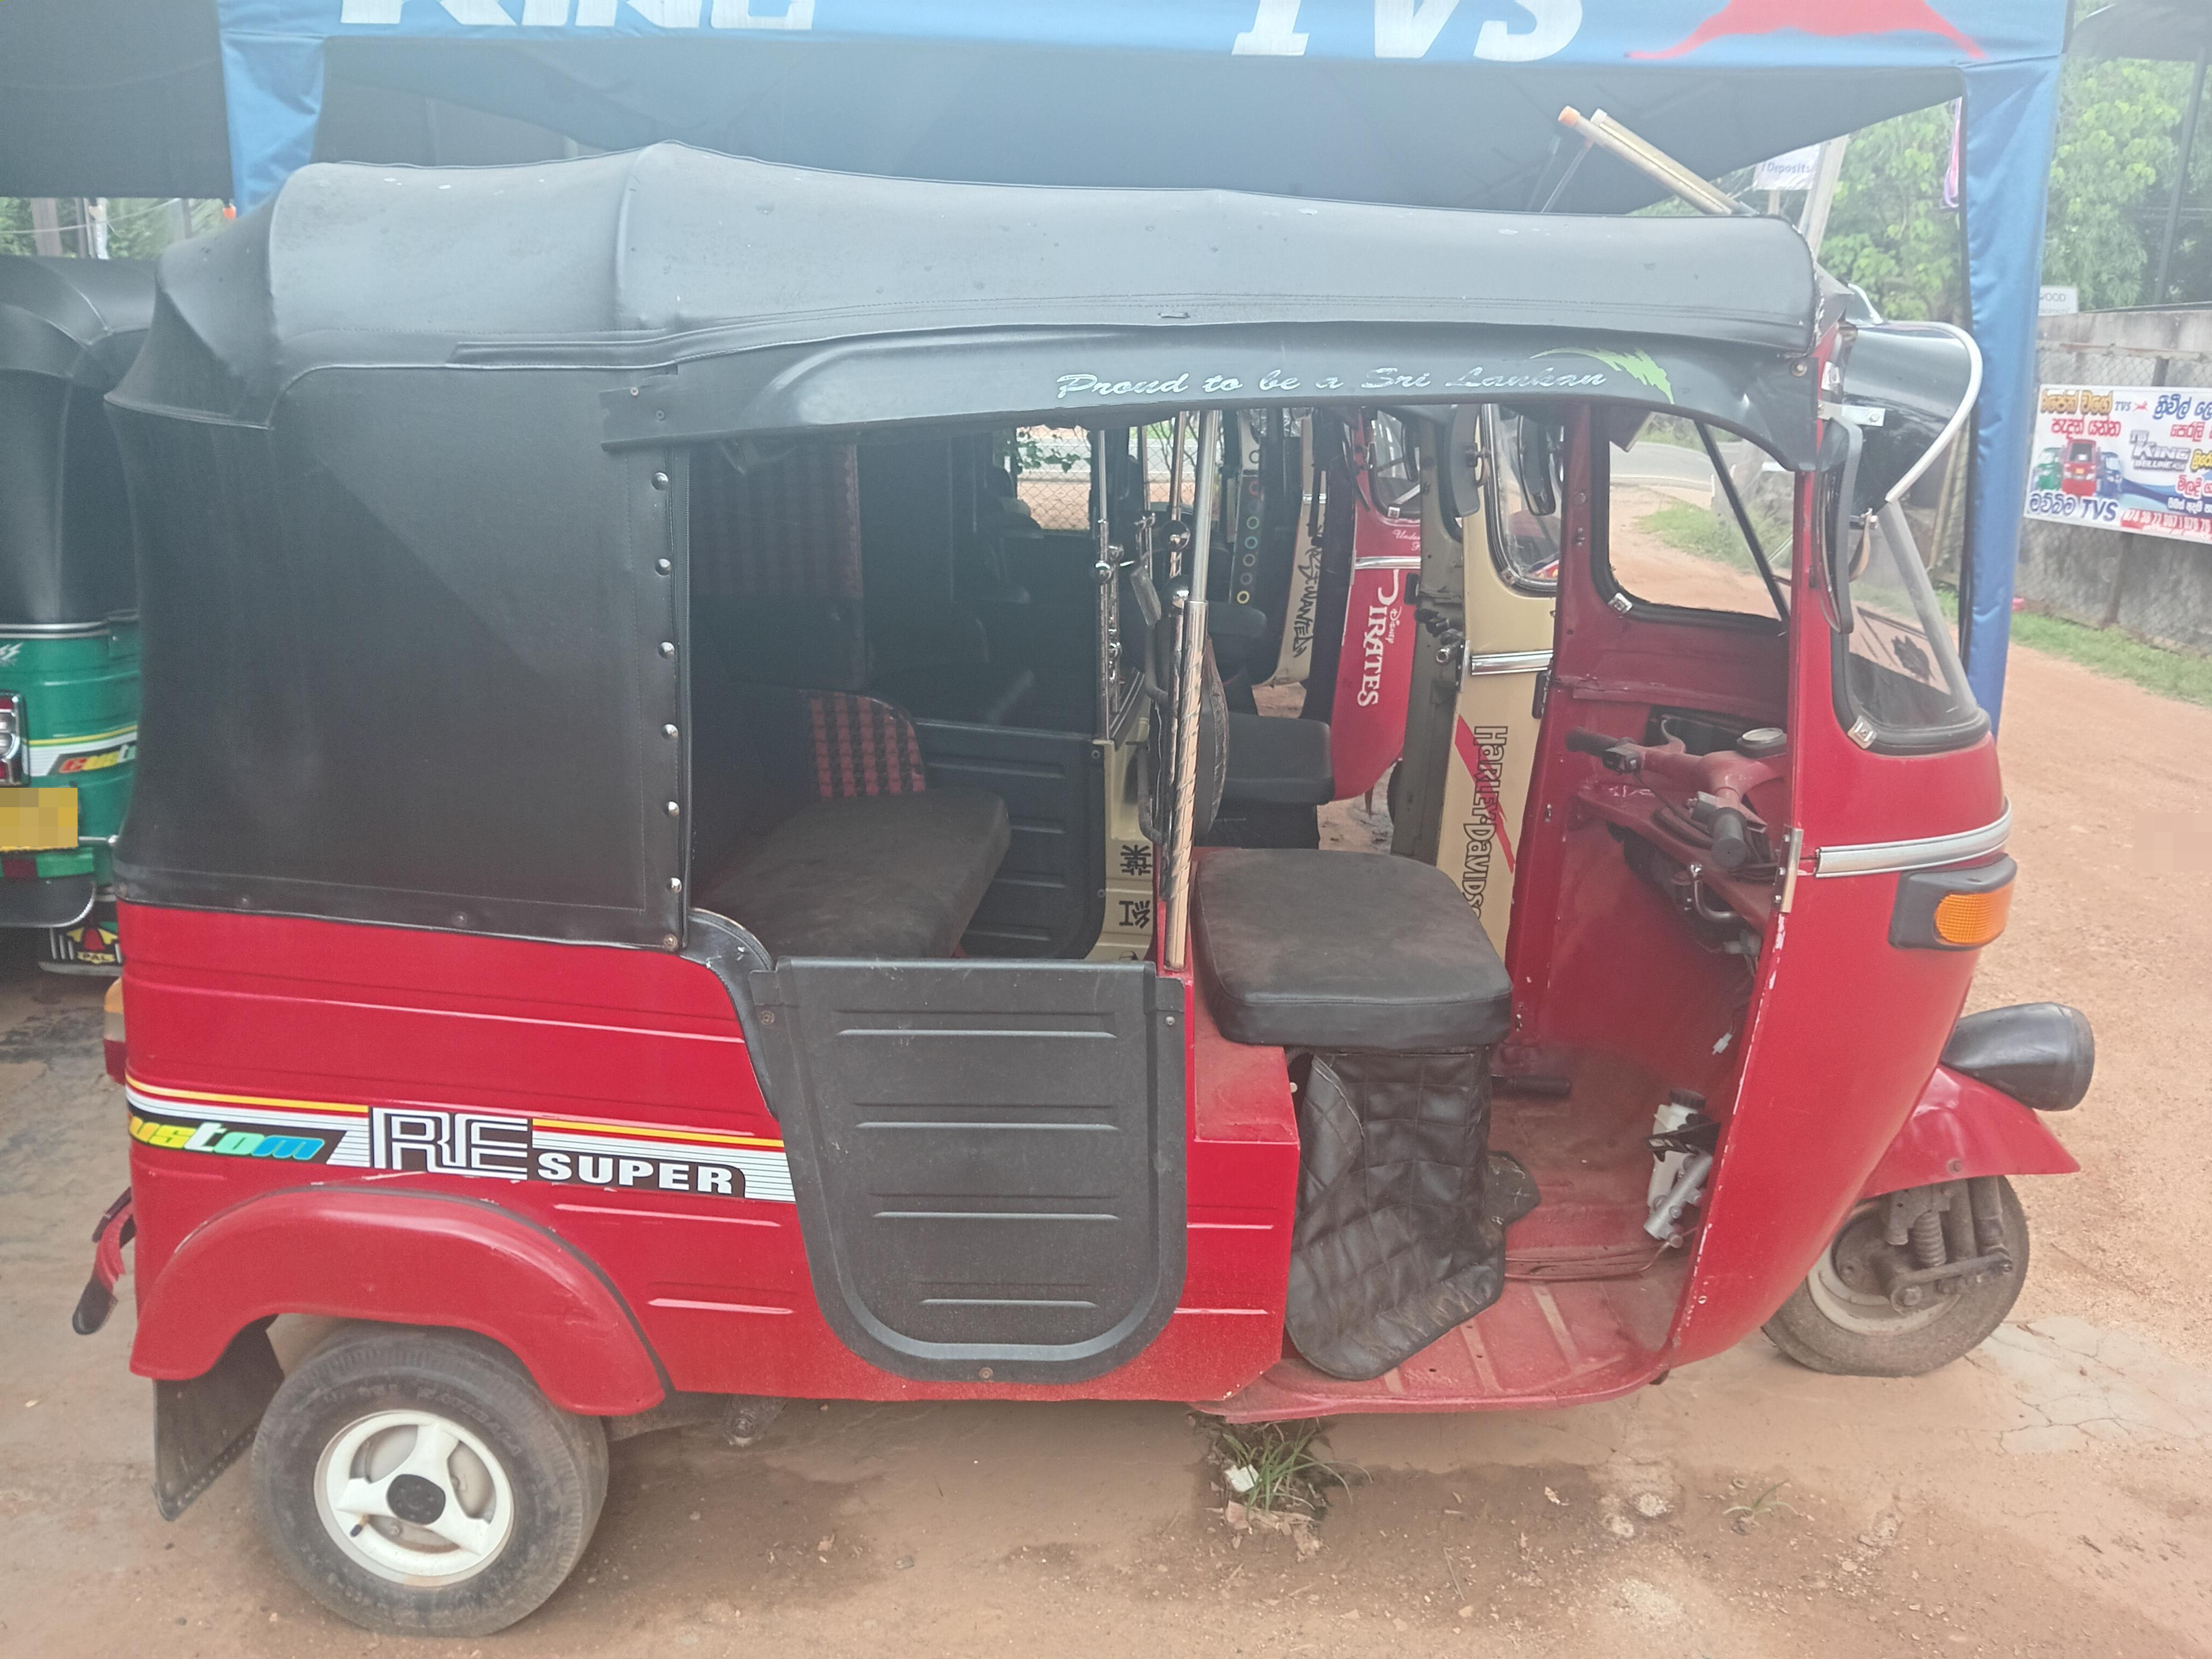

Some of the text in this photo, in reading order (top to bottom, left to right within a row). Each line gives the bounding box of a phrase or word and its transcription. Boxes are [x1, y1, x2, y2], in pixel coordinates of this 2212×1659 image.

[1057, 366, 1607, 398] Proud to be a Sri Lankan
[2115, 401, 2132, 411] TVS
[2081, 498, 2119, 522] TVS
[1356, 569, 1399, 706] PIRATES
[128, 1108, 734, 1194] ustom RE SUPER
